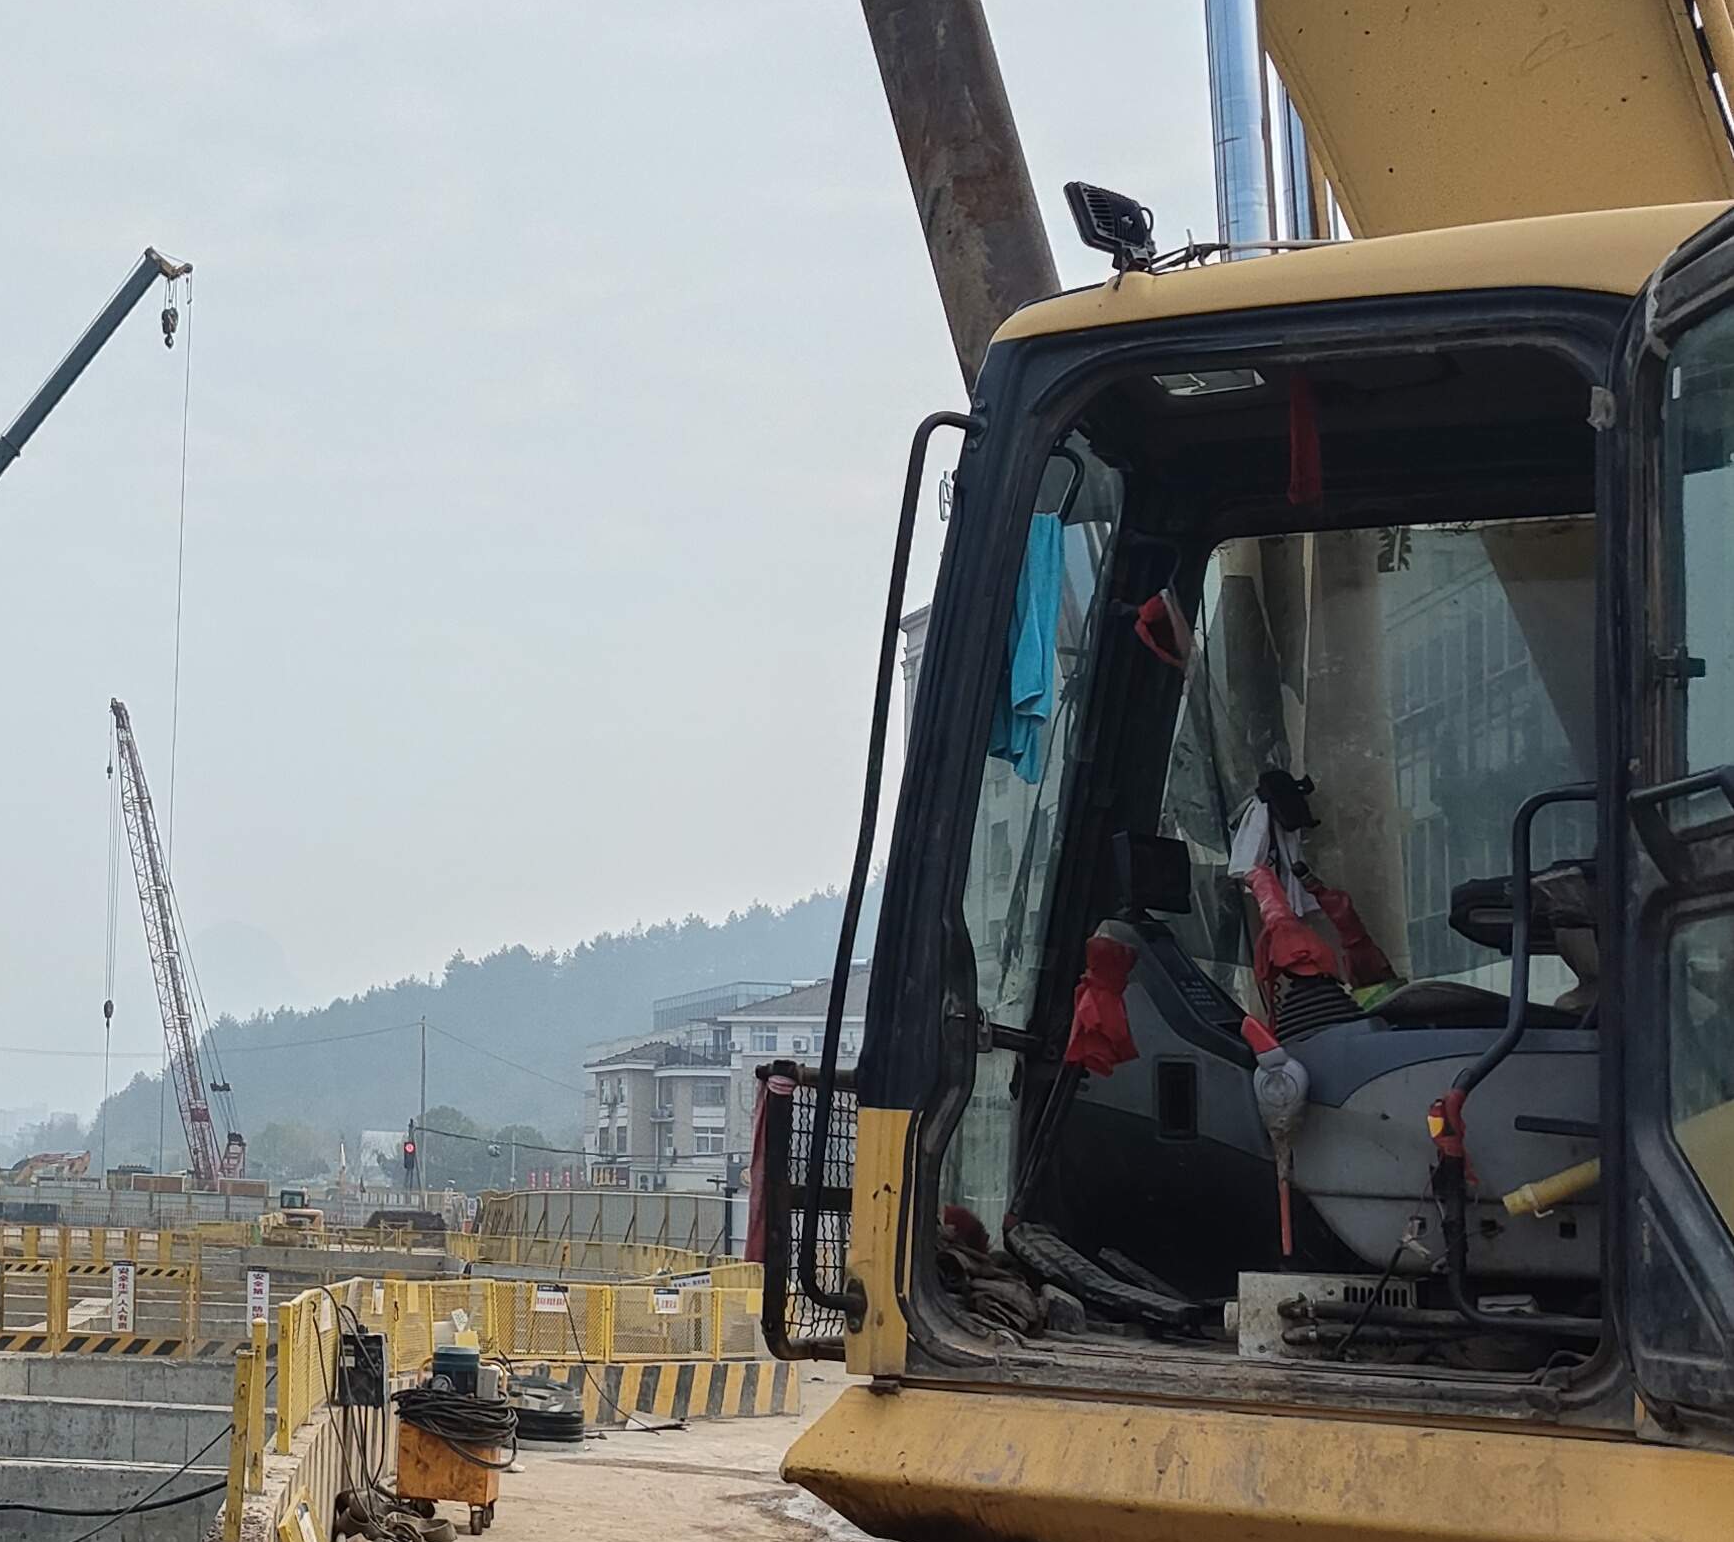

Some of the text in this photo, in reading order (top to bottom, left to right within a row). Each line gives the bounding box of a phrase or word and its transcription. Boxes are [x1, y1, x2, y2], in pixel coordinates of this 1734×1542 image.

[117, 1267, 130, 1297] 安全生产
[252, 1273, 265, 1300] 安全第一
